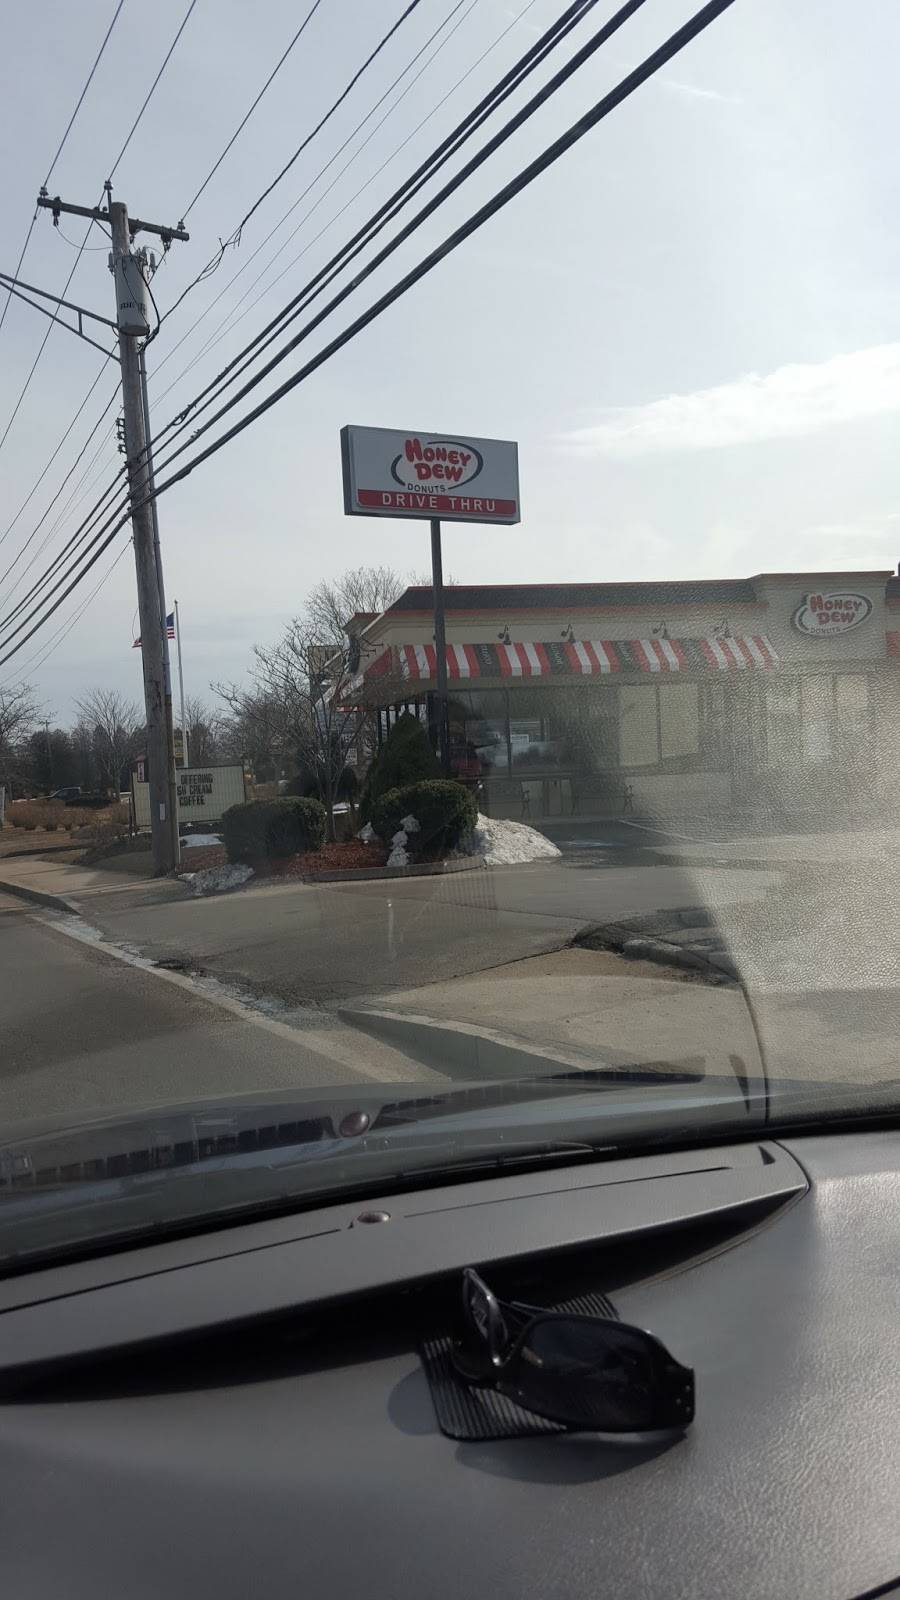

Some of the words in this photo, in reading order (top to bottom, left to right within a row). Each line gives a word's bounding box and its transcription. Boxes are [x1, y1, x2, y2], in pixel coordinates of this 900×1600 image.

[404, 438, 472, 467] HONEY
[414, 462, 464, 482] DEW
[407, 483, 446, 493] DONUTS
[382, 492, 438, 508] DRIVE
[450, 497, 496, 512] THRU
[809, 593, 862, 612] HONEY
[817, 611, 856, 625] DEW
[179, 794, 206, 807] COFFEE
